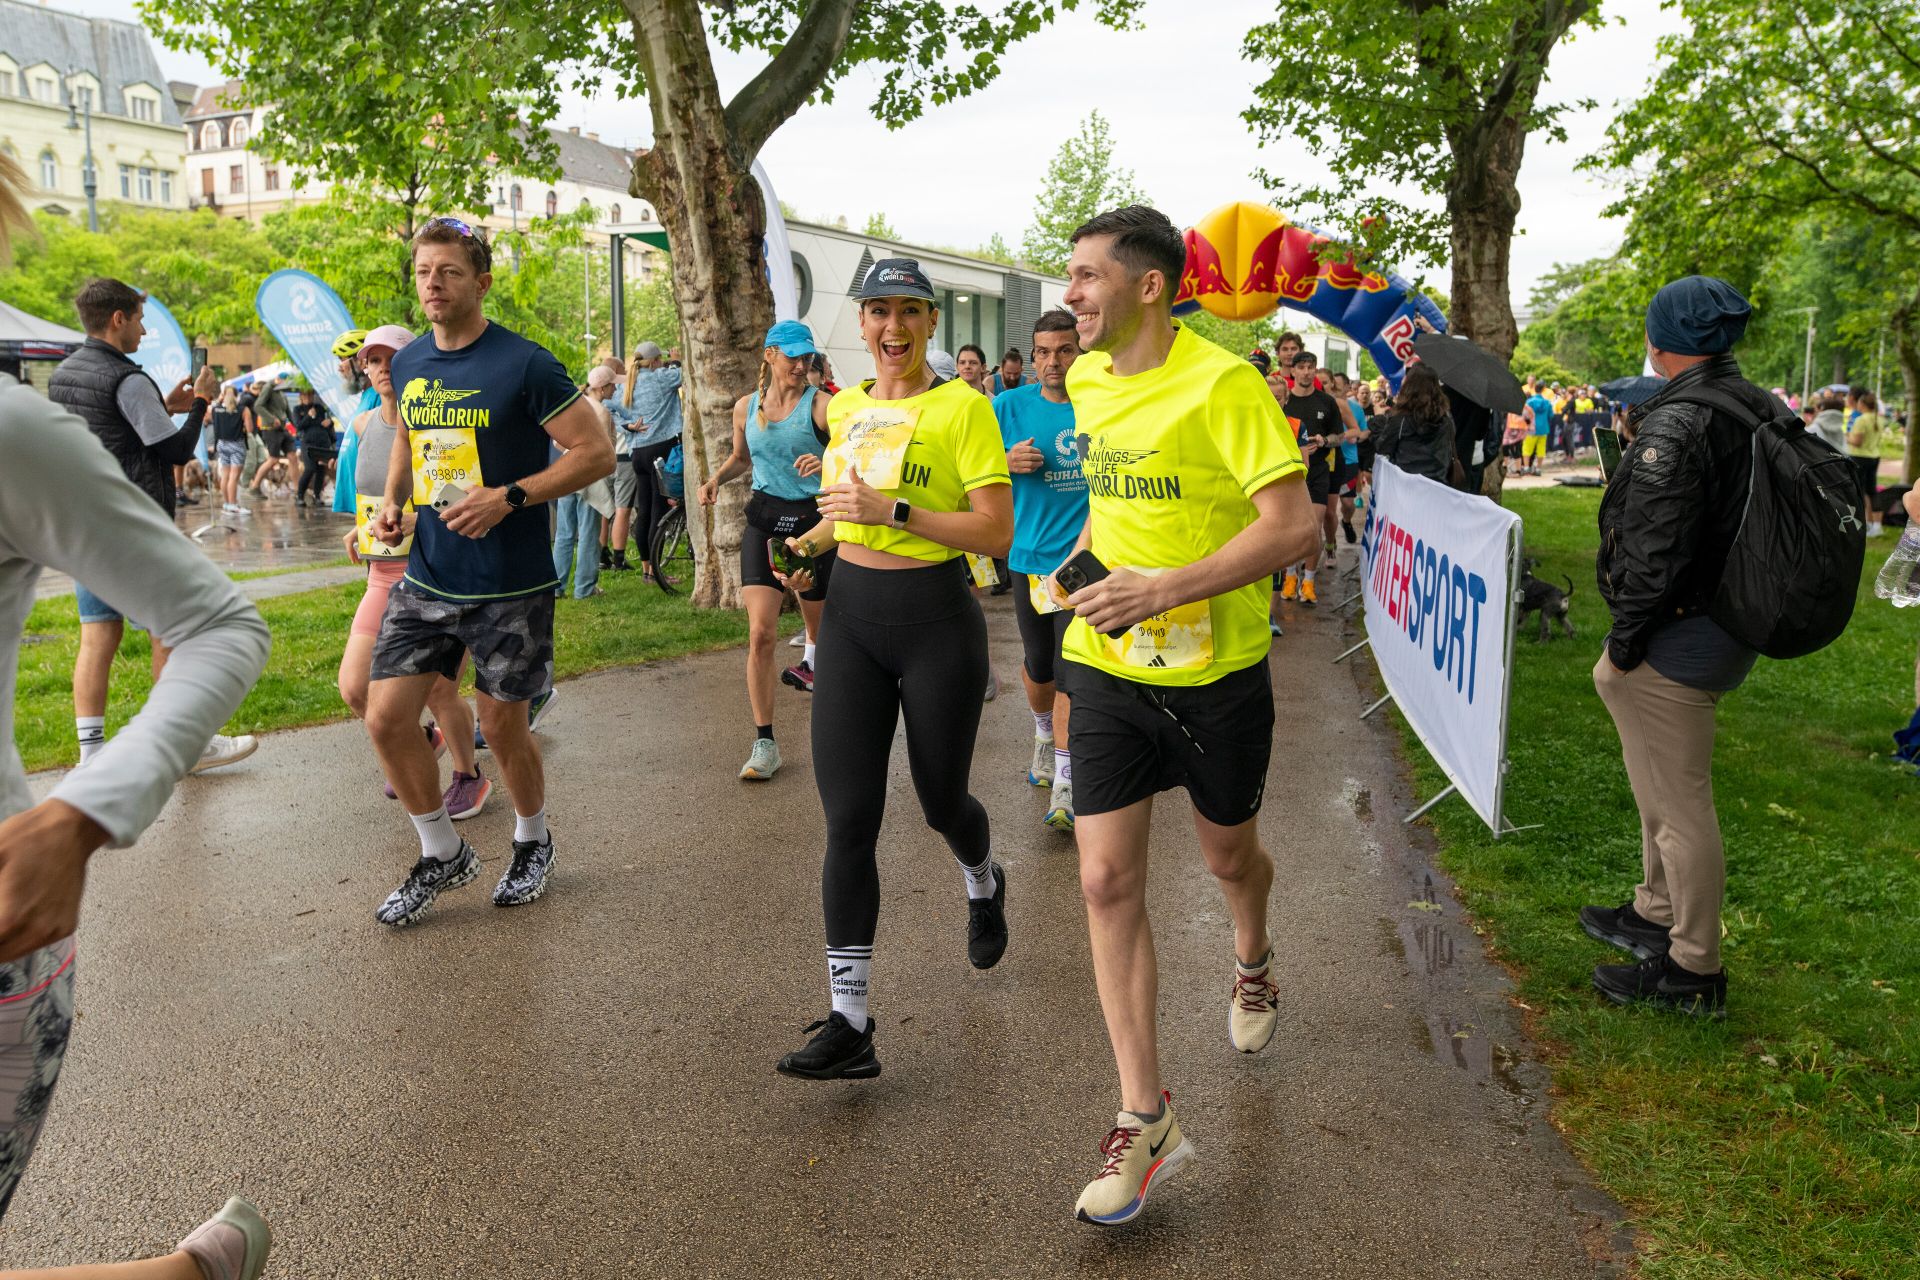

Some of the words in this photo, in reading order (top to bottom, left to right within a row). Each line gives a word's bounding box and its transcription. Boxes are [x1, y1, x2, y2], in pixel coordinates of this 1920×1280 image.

[1383, 318, 1417, 361] Re
[424, 390, 457, 399] WINGS
[427, 399, 446, 407] LIFE
[411, 406, 490, 428] WORLDRUN
[1089, 449, 1129, 463] WINGS
[426, 469, 466, 481] 193809
[1095, 462, 1118, 475] LIFE
